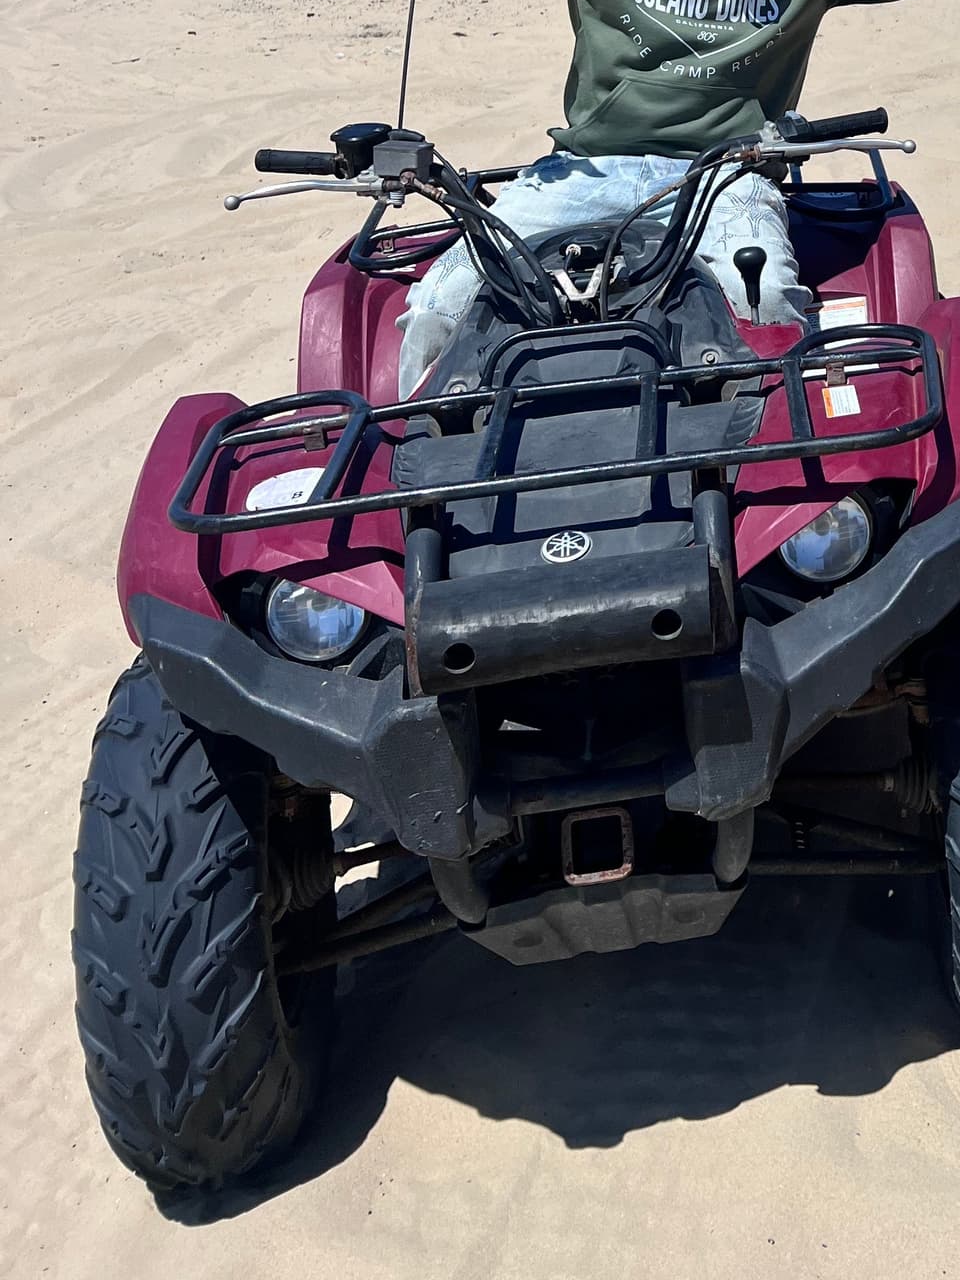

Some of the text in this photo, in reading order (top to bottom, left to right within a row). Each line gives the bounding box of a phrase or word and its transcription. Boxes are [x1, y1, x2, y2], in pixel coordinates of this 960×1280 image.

[675, 19, 734, 31] CALIFORNIA
[696, 30, 719, 44] 805
[619, 13, 652, 58] RIDE
[659, 61, 717, 79] CAMP
